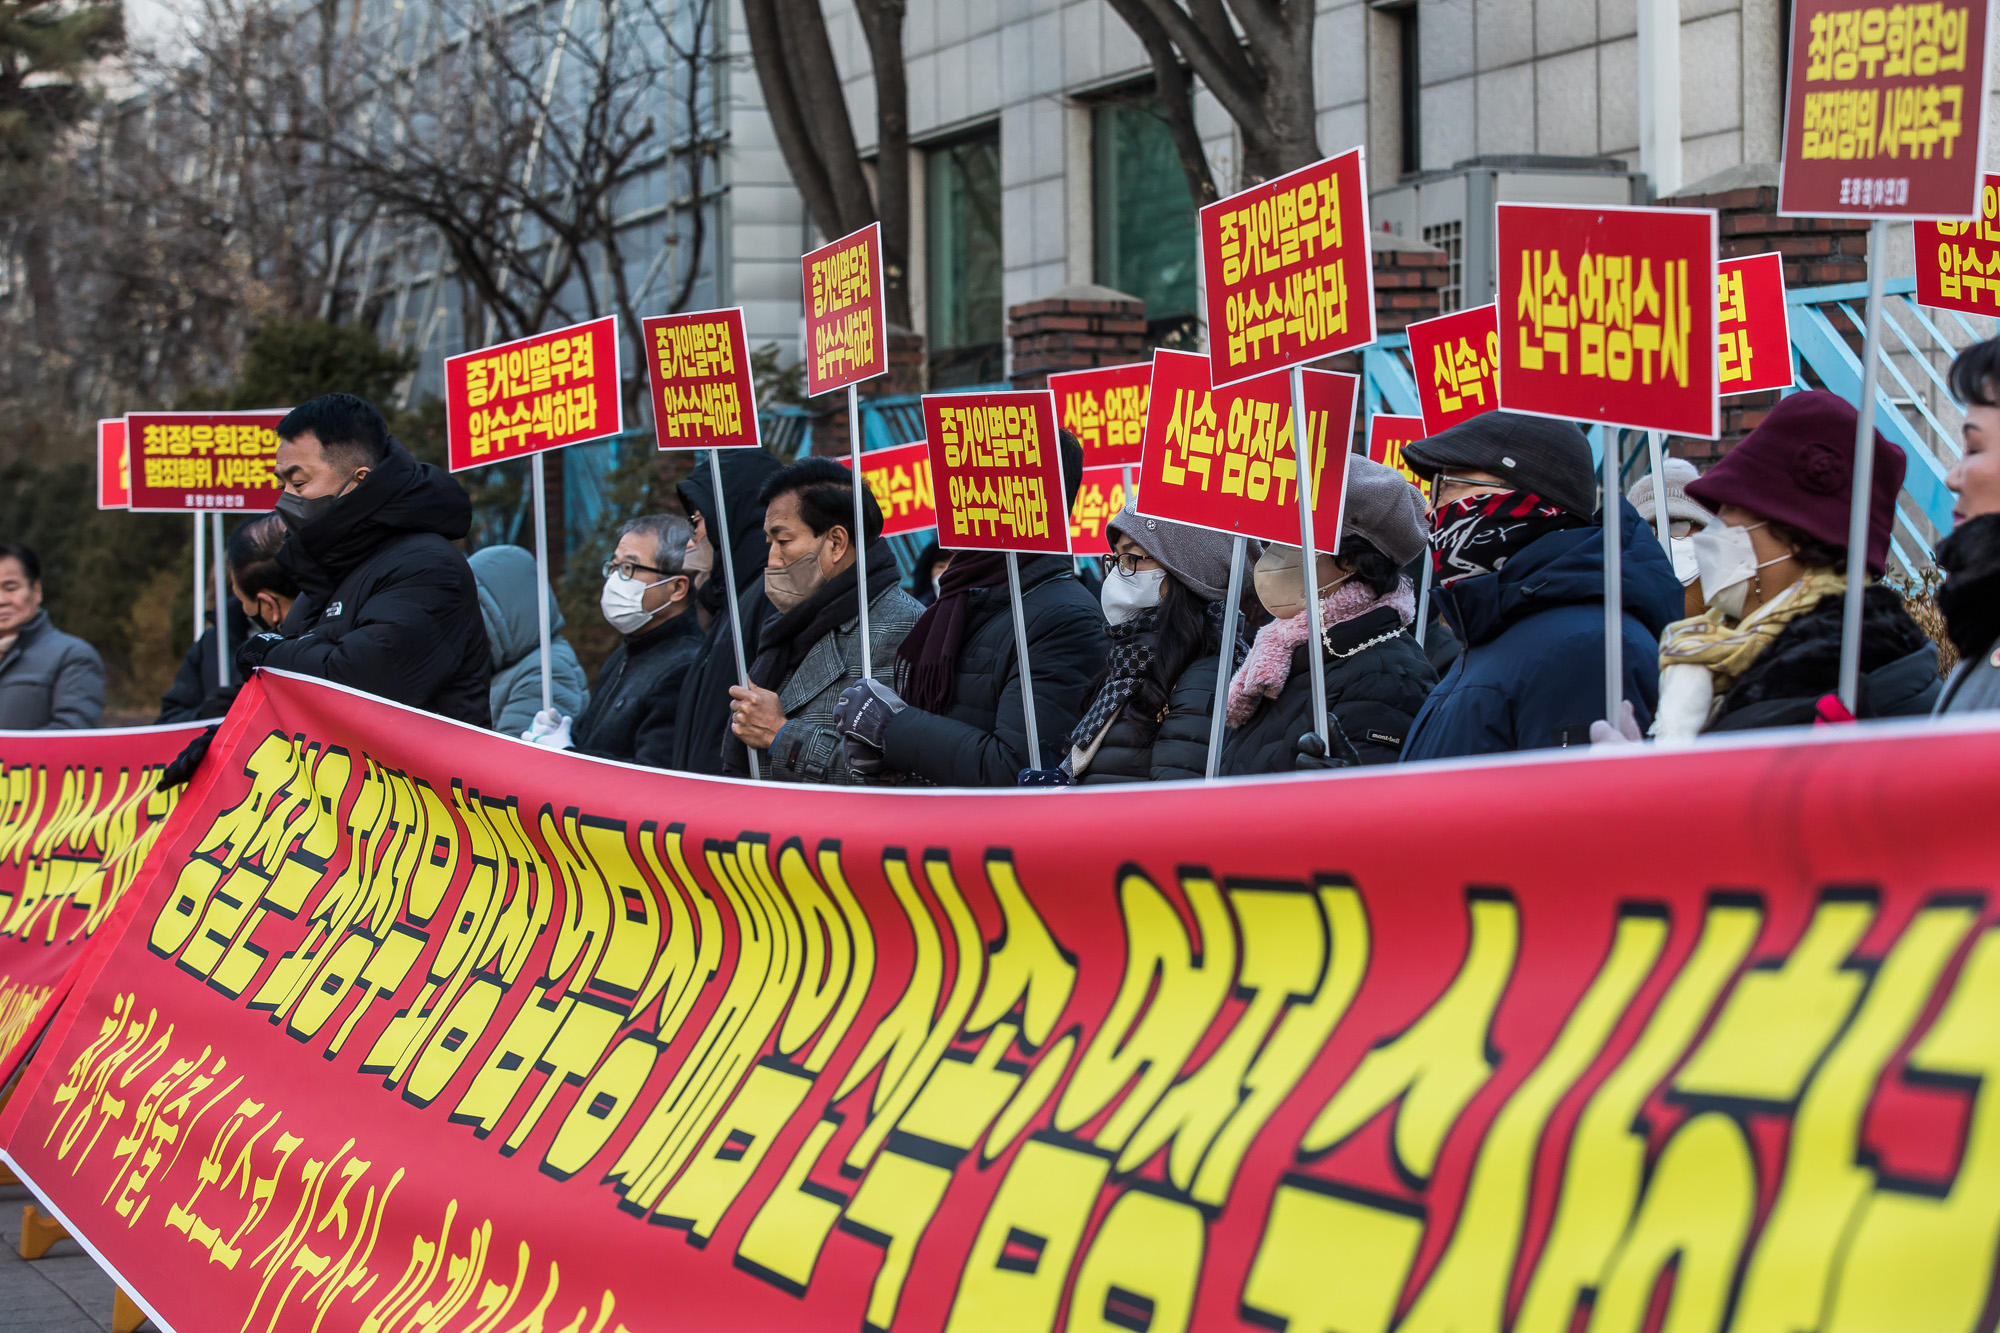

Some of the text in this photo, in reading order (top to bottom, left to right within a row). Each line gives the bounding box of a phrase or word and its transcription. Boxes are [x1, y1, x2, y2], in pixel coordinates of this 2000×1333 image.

[1807, 3, 1967, 81] 최정우회장의
[1802, 85, 1962, 159] 범죄행위 사익추구
[1220, 173, 1342, 285] 증거인멸우려
[812, 241, 870, 318] 증거인멸우려
[1226, 259, 1347, 366] 압수수색하라
[656, 321, 734, 379] 증거인멸우려
[816, 307, 873, 380] 압수수색하라
[1518, 250, 1690, 387] 신속·엄정수사
[467, 332, 594, 407] 증거인멸우려
[144, 425, 281, 455] 최정우회장의
[469, 384, 597, 457] 압수수색하라
[664, 382, 742, 437] 압수수색하라
[940, 405, 1041, 467] 증거인멸우려
[145, 458, 212, 488] 범죄행위
[949, 476, 1049, 538] 압수수색하라
[246, 751, 460, 1062] 최정우
[357, 777, 555, 1109] 회장
[447, 802, 724, 1182] 업무상
[599, 831, 876, 1251] 배임
[43, 993, 174, 1177] 최정우
[102, 1045, 244, 1229] 퇴출!
[165, 1097, 304, 1271] 포스코
